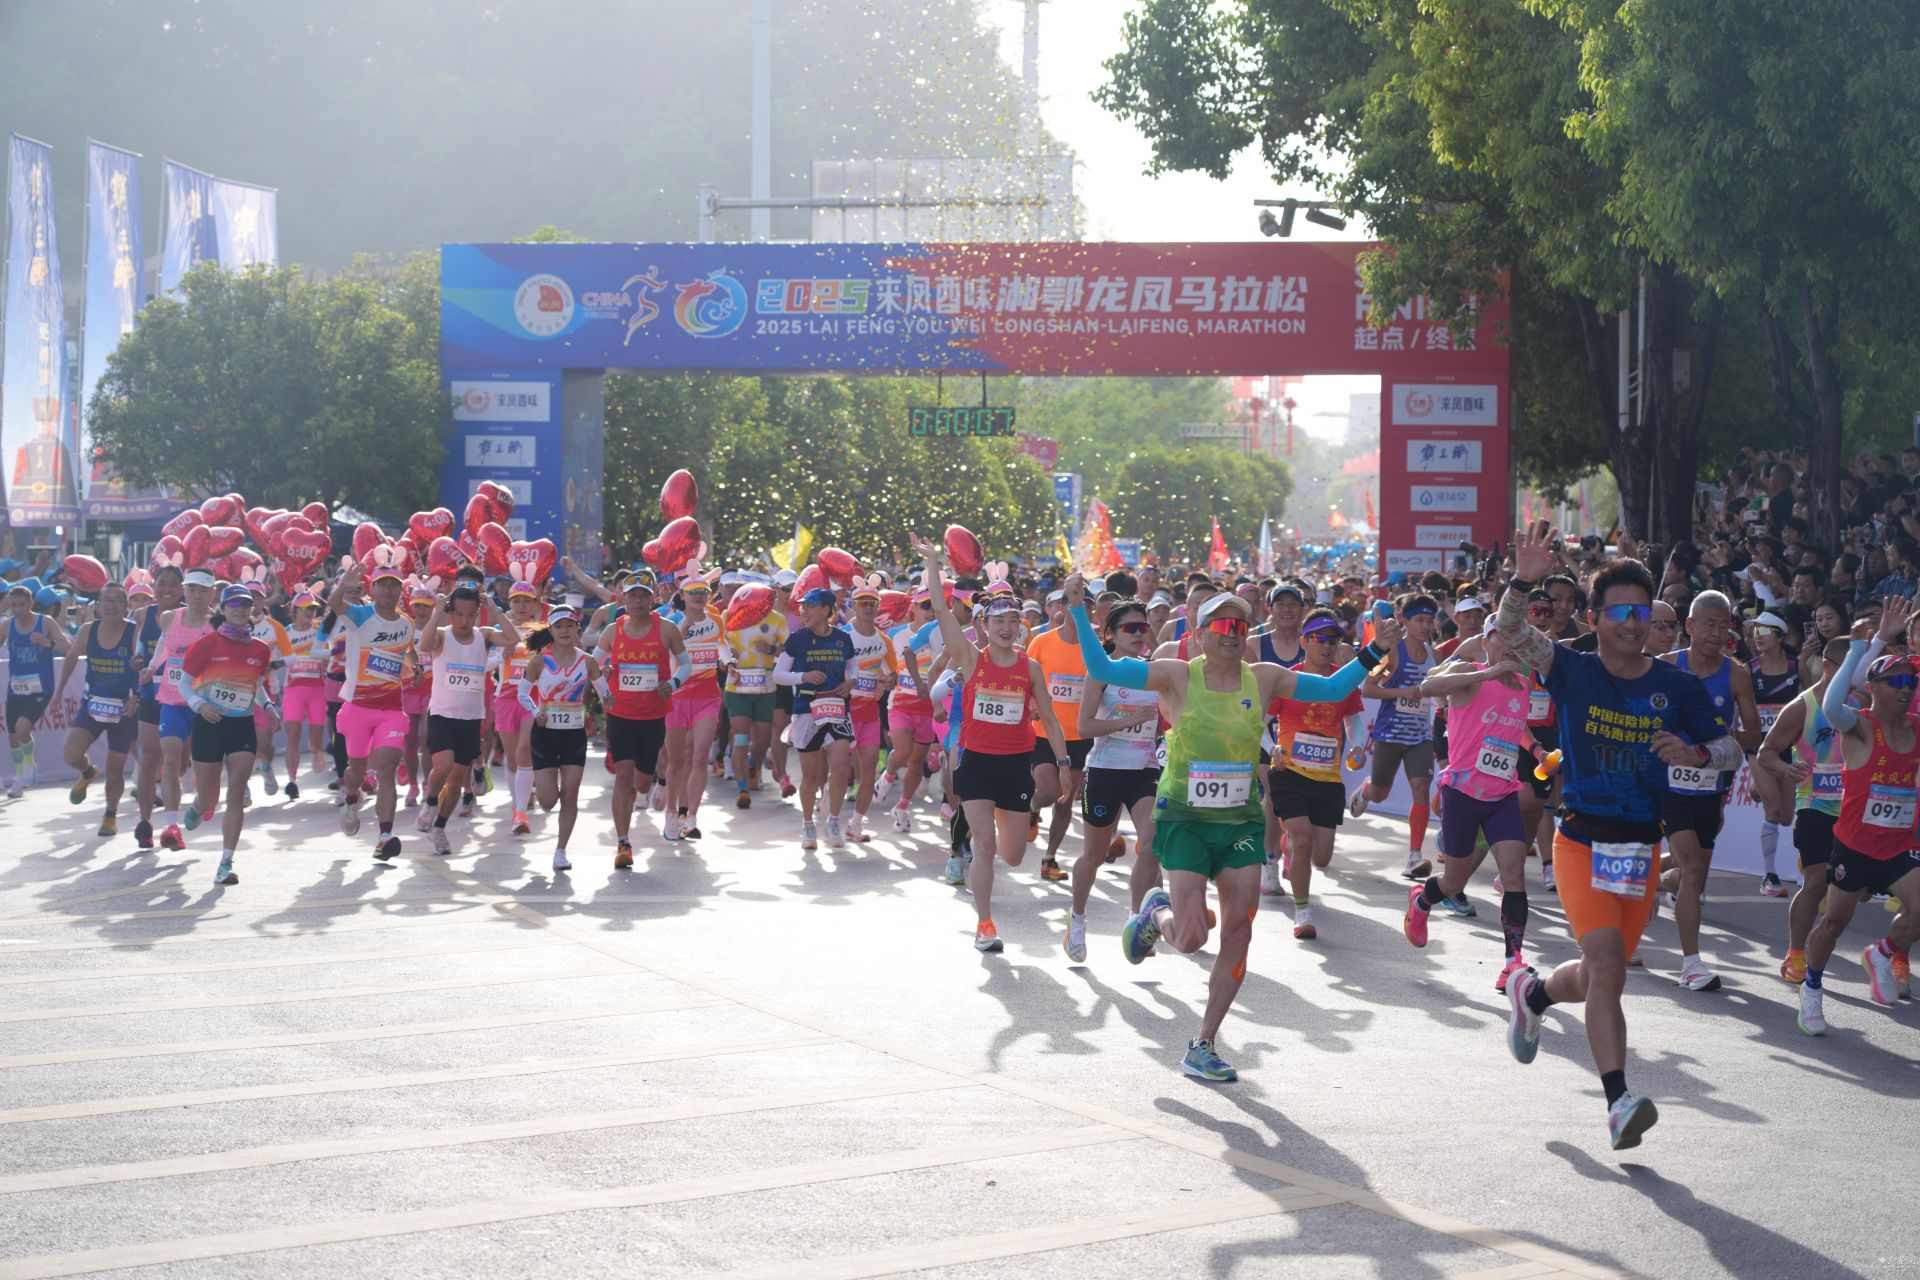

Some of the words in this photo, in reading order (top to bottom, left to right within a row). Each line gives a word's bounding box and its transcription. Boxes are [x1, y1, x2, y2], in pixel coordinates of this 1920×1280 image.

[582, 292, 632, 307] CHINA
[756, 279, 870, 314] 2025
[756, 320, 802, 335] 2025
[809, 320, 839, 335] LAI
[847, 319, 895, 335] FENG
[904, 319, 942, 335] YOU
[1197, 318, 1306, 334] MARATHON
[423, 513, 449, 527] 4:00
[287, 545, 319, 560] 6:00
[508, 548, 540, 562] 4:30
[169, 670, 181, 681] 08
[449, 674, 470, 685] 079
[622, 675, 642, 686] 027
[215, 689, 236, 703] 199
[1052, 686, 1072, 697] 021
[90, 702, 120, 715] A2686
[978, 702, 1004, 717] 188
[1400, 697, 1420, 709] 080
[551, 713, 570, 724] 112
[1588, 705, 1663, 729] 中国探险协会
[1297, 744, 1334, 759] A2868
[1482, 753, 1509, 771] 066
[1672, 767, 1701, 783] 036
[1195, 781, 1229, 799] 091
[1870, 803, 1902, 819] 097
